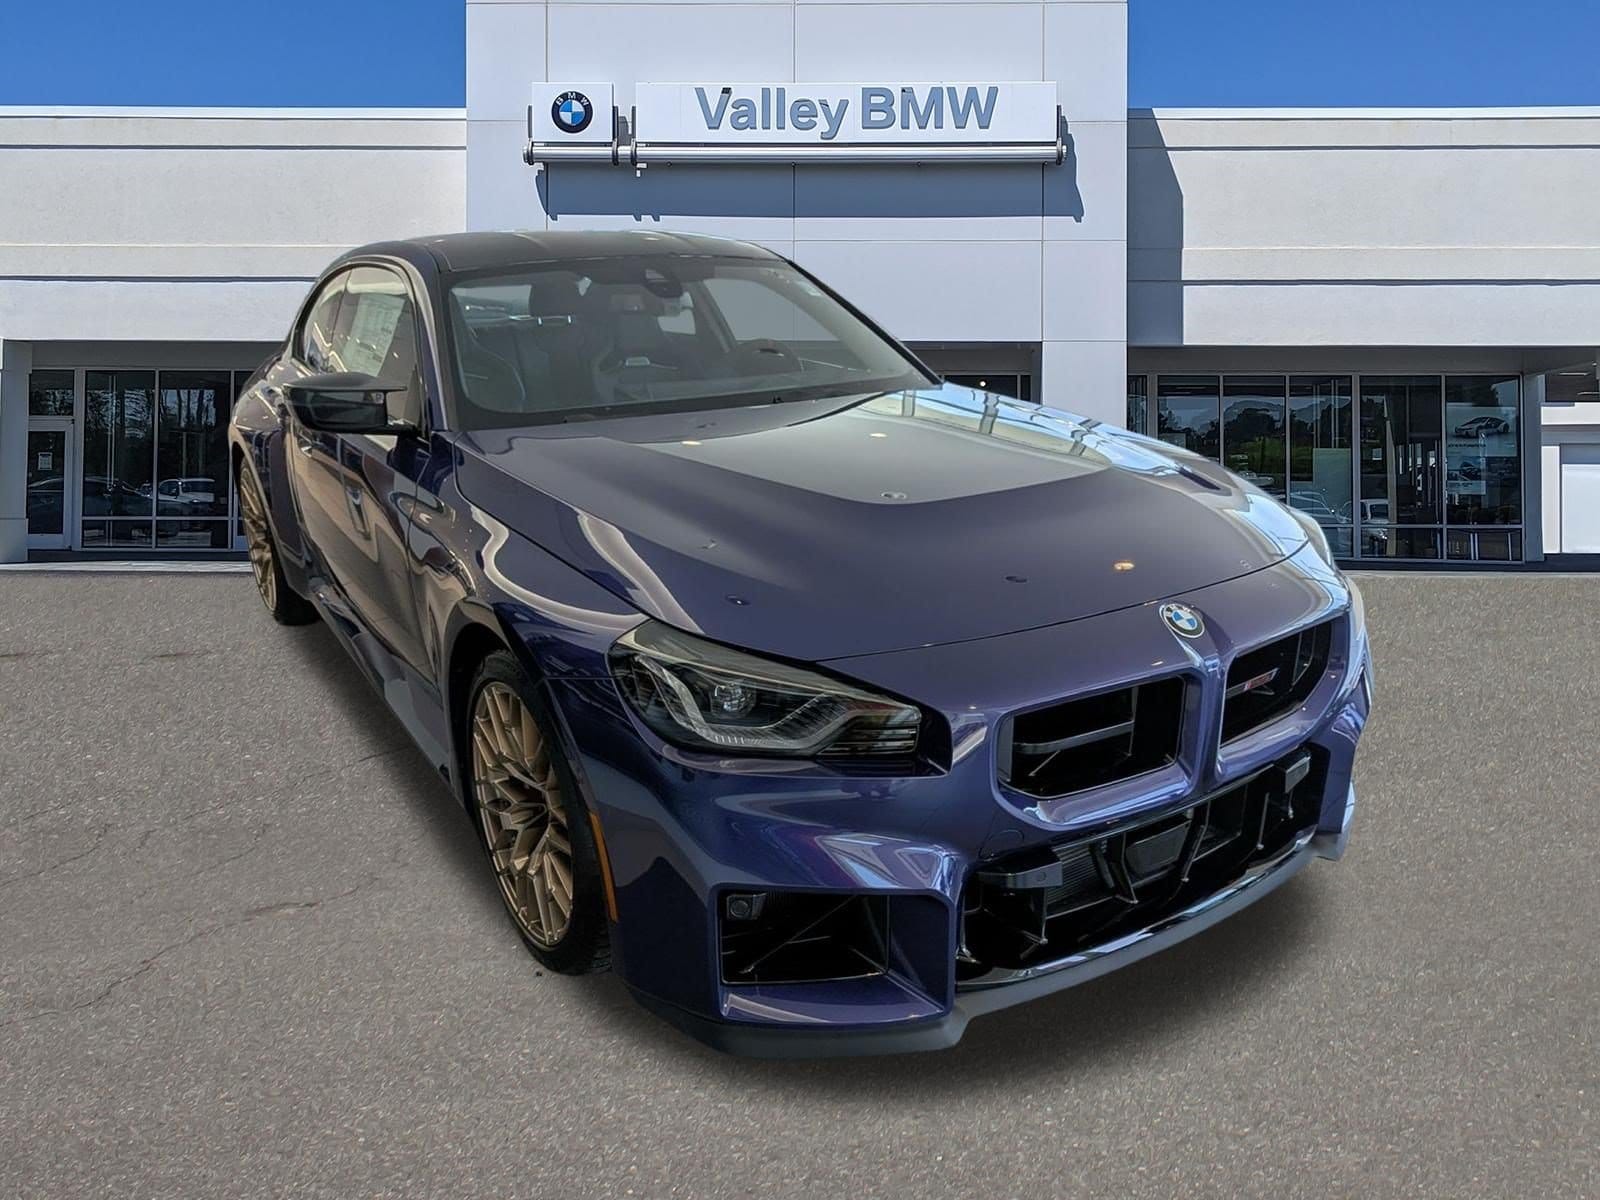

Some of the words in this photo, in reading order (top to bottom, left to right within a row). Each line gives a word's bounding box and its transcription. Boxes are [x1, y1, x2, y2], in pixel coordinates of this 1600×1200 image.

[555, 92, 589, 106] BMW
[695, 87, 849, 141] Valley
[861, 86, 999, 130] BMW
